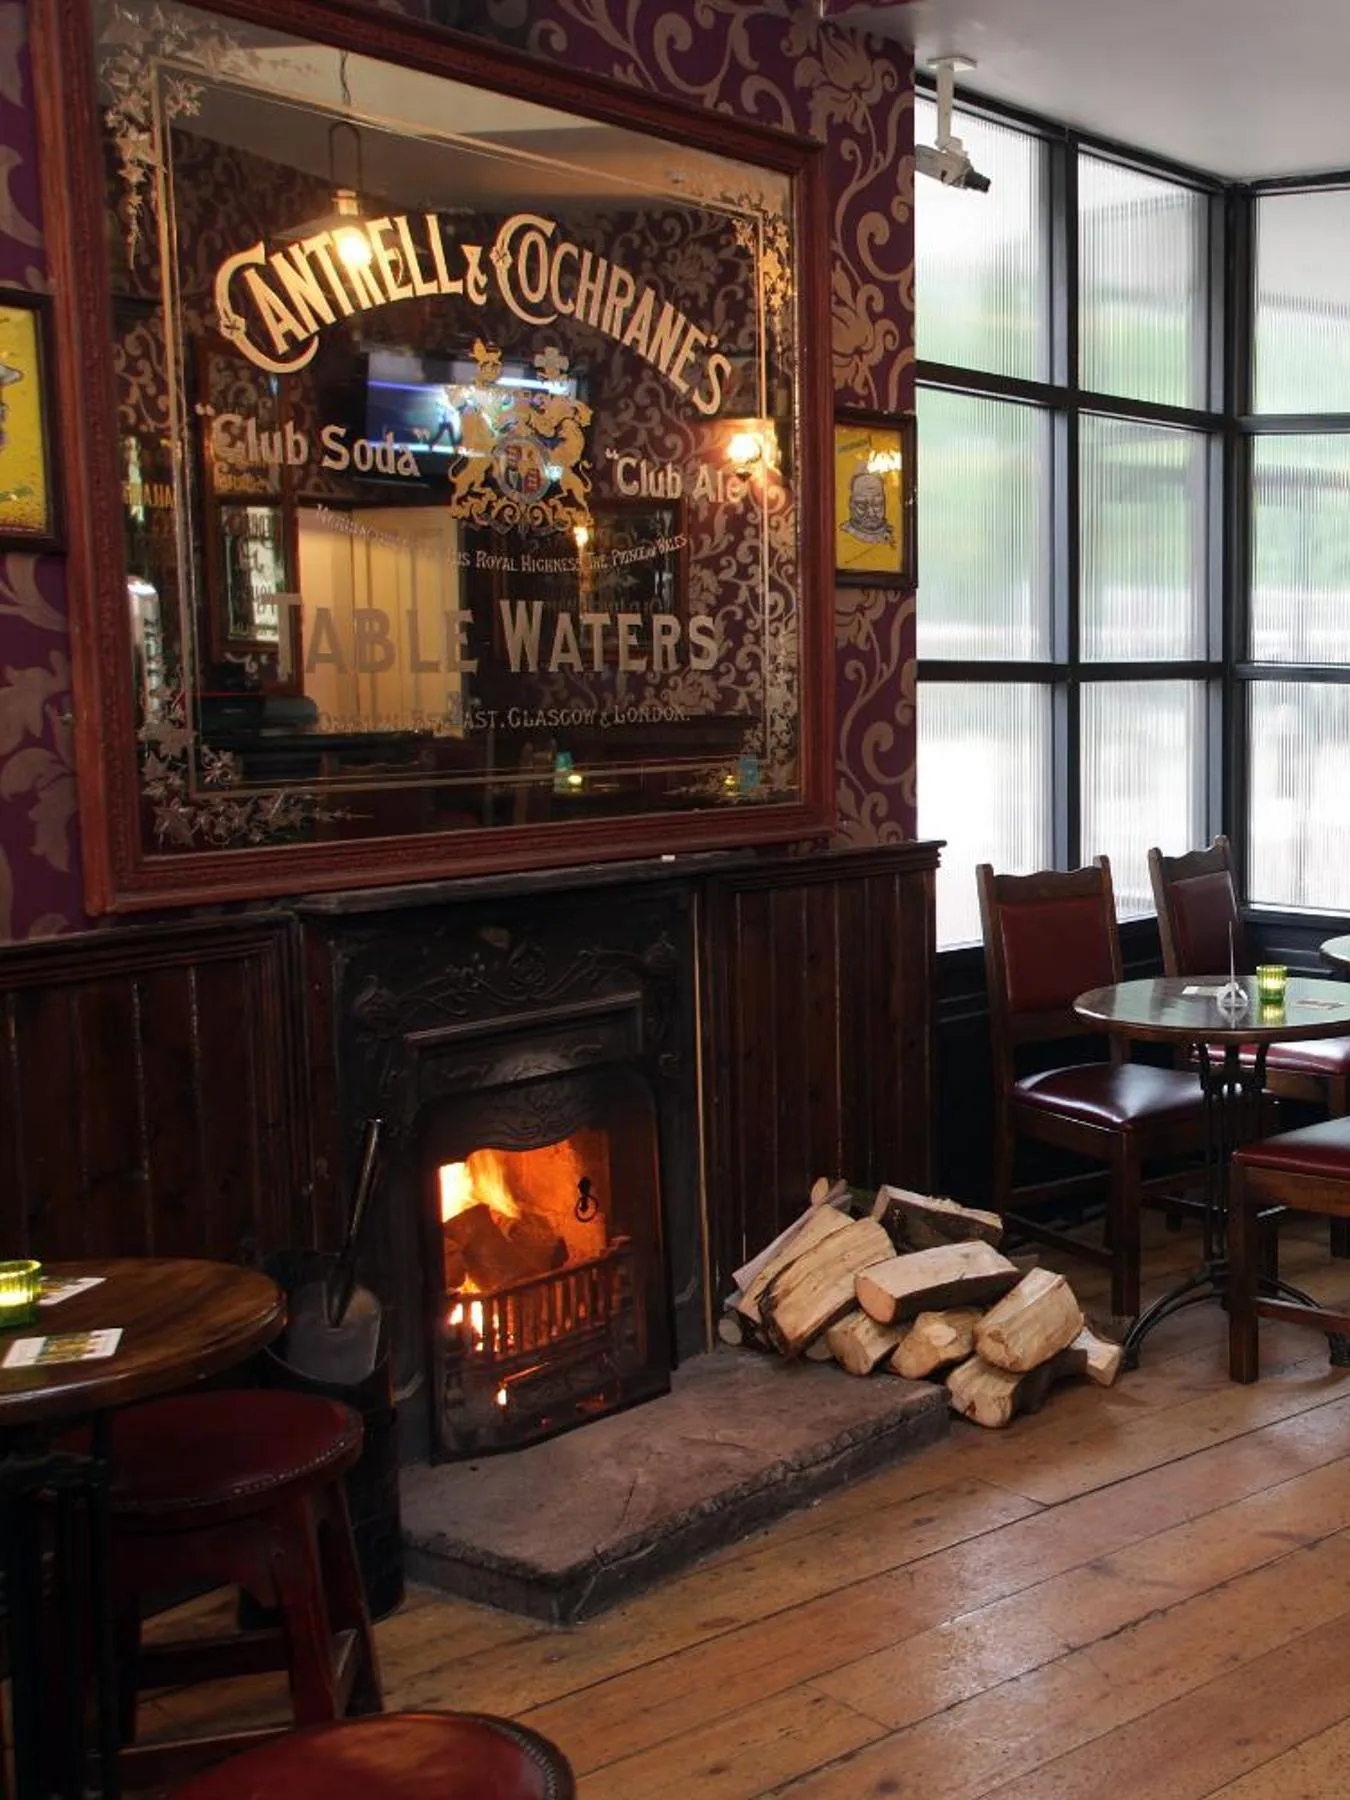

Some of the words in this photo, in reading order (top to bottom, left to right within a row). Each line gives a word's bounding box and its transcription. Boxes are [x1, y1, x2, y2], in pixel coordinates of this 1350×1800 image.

[215, 214, 463, 373] CANTRELL
[461, 245, 487, 305] &
[489, 213, 732, 415] COCHRANE'S
[475, 550, 519, 571] ROYAL
[262, 593, 479, 681] TABLE
[500, 599, 719, 673] WATERS
